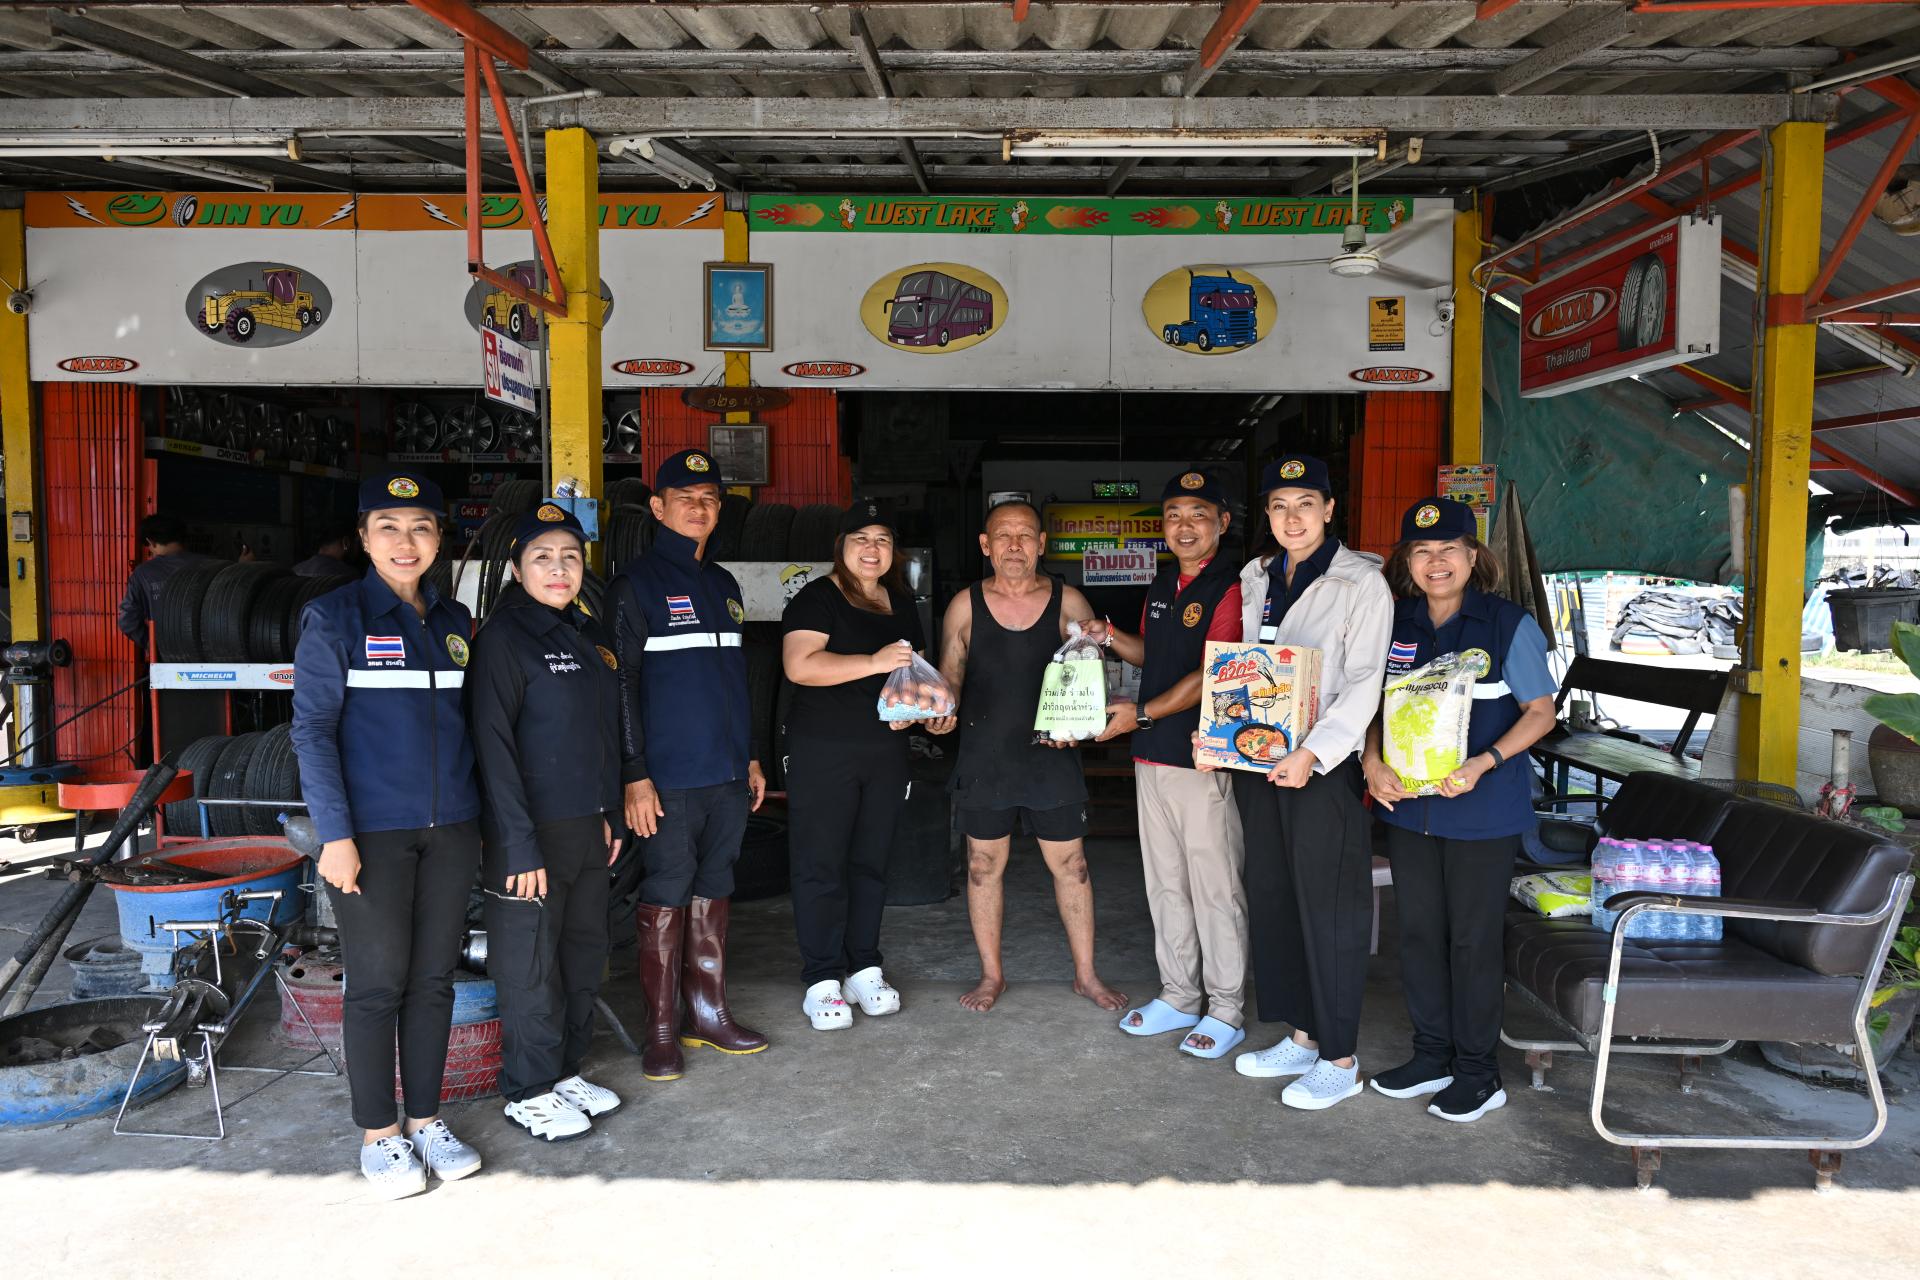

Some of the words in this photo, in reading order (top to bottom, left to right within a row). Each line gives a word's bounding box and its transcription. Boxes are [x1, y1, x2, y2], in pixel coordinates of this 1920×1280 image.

[197, 204, 251, 225] JIN
[259, 204, 303, 225] YU
[616, 204, 661, 226] YU
[864, 201, 934, 225] WEST
[935, 202, 999, 227] LAKE
[1240, 202, 1308, 226] WEST
[1540, 290, 1596, 336] MAXXIS
[1545, 340, 1591, 371] Thailand
[70, 358, 126, 372] MAXXIS
[625, 360, 682, 375] MAXXIS
[794, 362, 853, 377] MAXXIS
[1362, 368, 1420, 383] MAXXIS
[217, 449, 249, 463] DAYTON
[1152, 541, 1168, 551] STY
[1084, 550, 1145, 570] ห้ามเข้า
[1132, 572, 1147, 581] Covid
